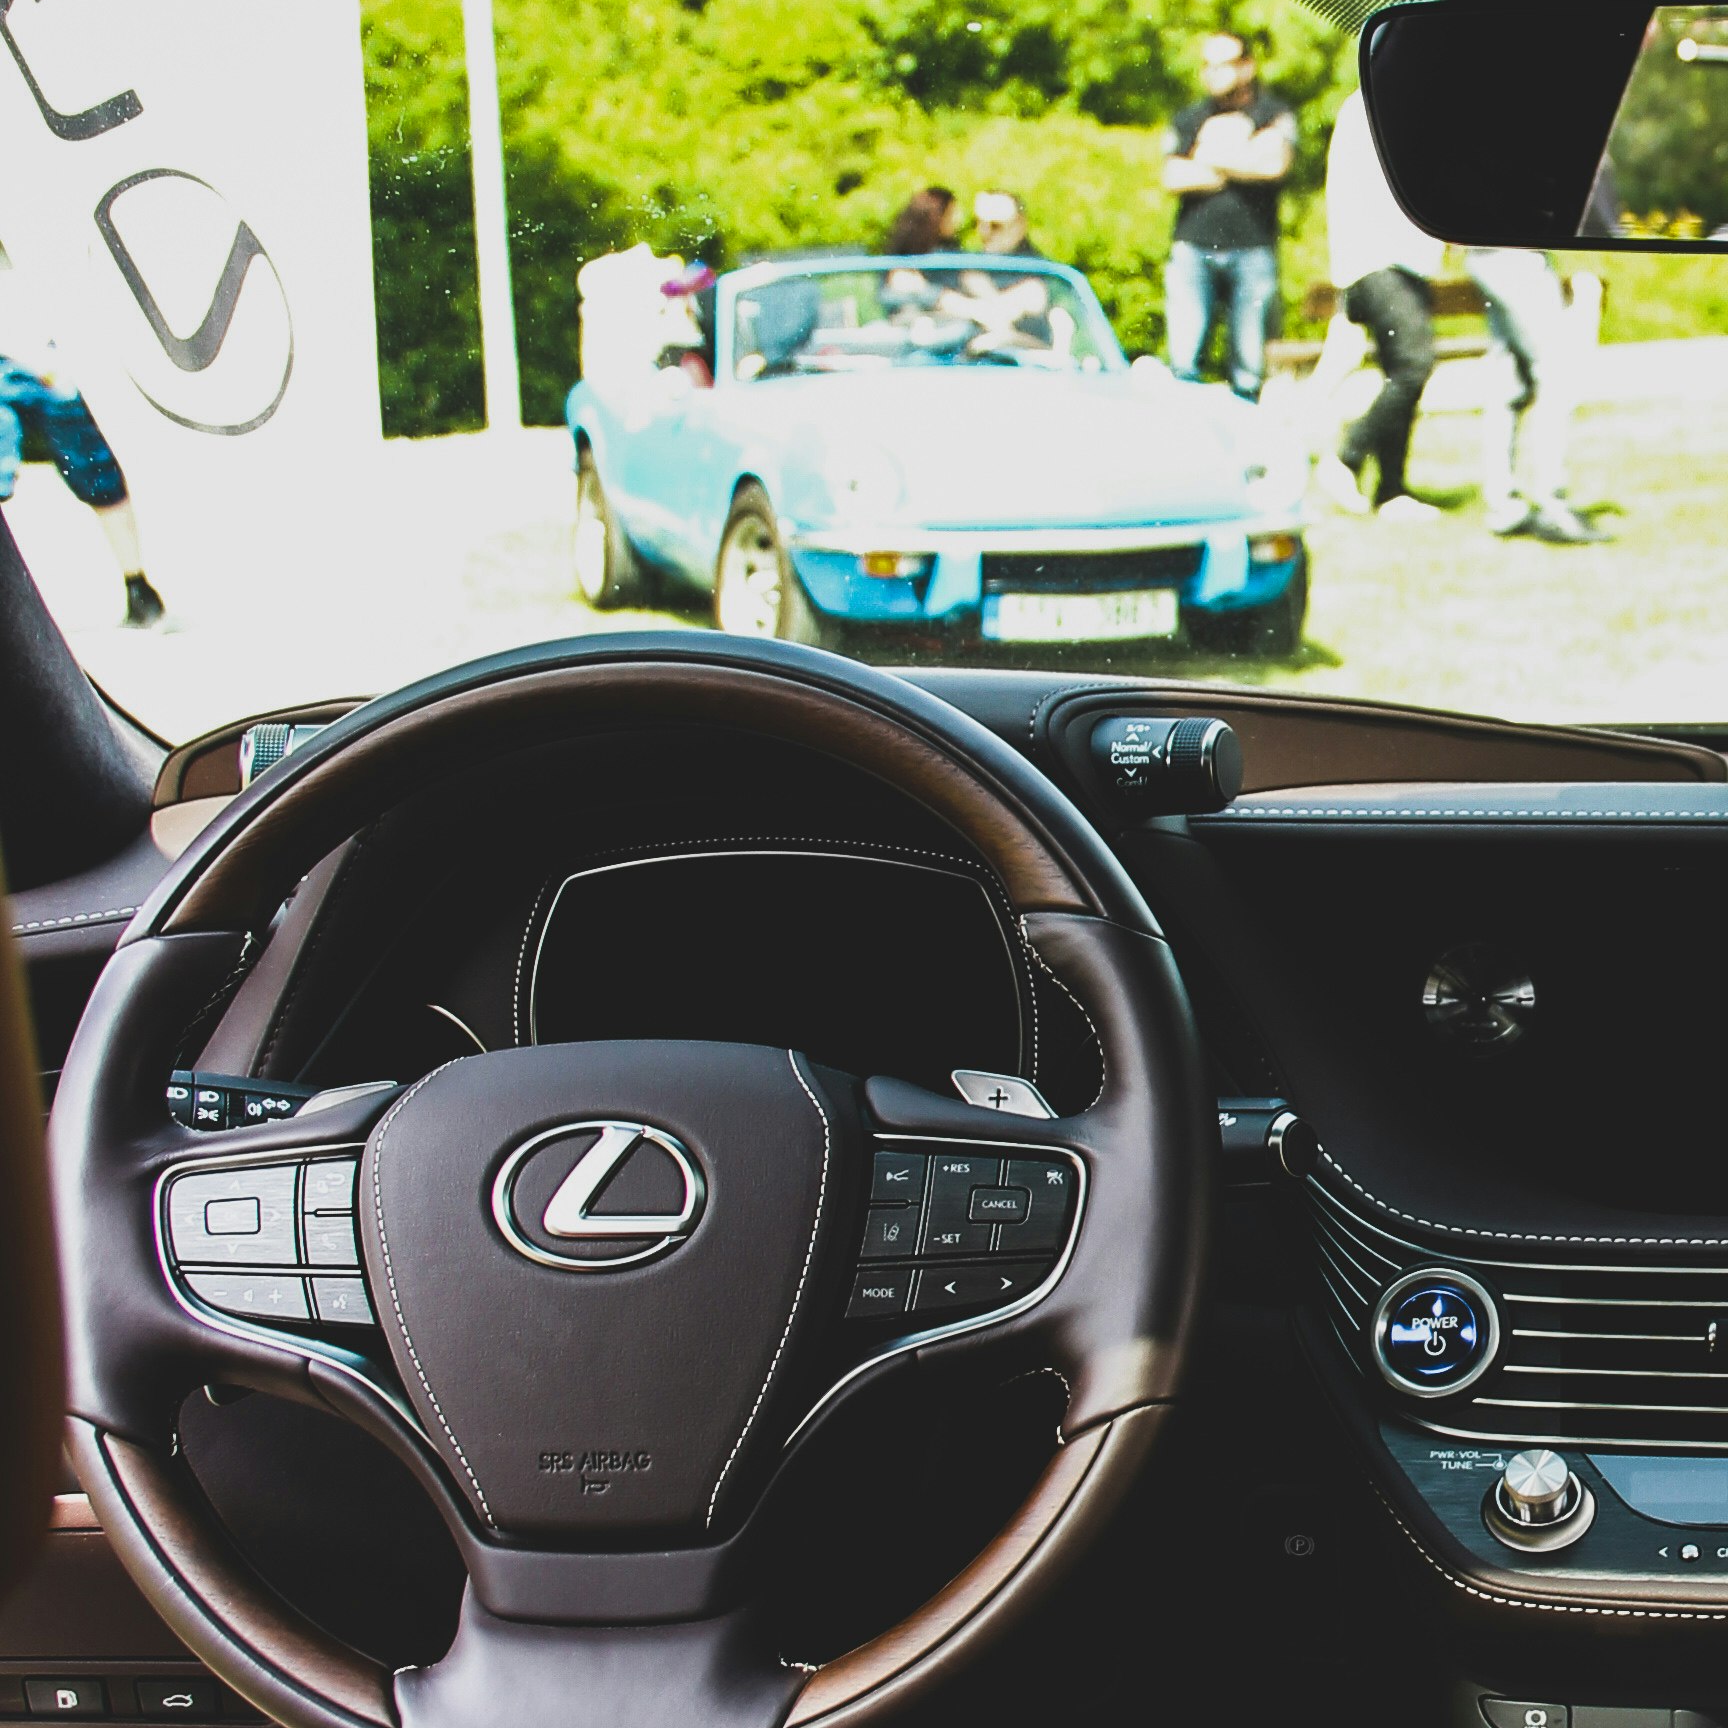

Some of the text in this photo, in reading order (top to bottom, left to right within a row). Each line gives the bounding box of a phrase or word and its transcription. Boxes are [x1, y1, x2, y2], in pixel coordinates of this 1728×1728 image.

[1111, 741, 1152, 753] Normal/
[1110, 753, 1150, 764] Custom
[981, 1200, 1018, 1209] CANCEL
[862, 1288, 895, 1298] MODE
[1411, 1316, 1459, 1329] POWER
[579, 1450, 652, 1472] AIRBAG
[1441, 1461, 1473, 1470] TUNE
